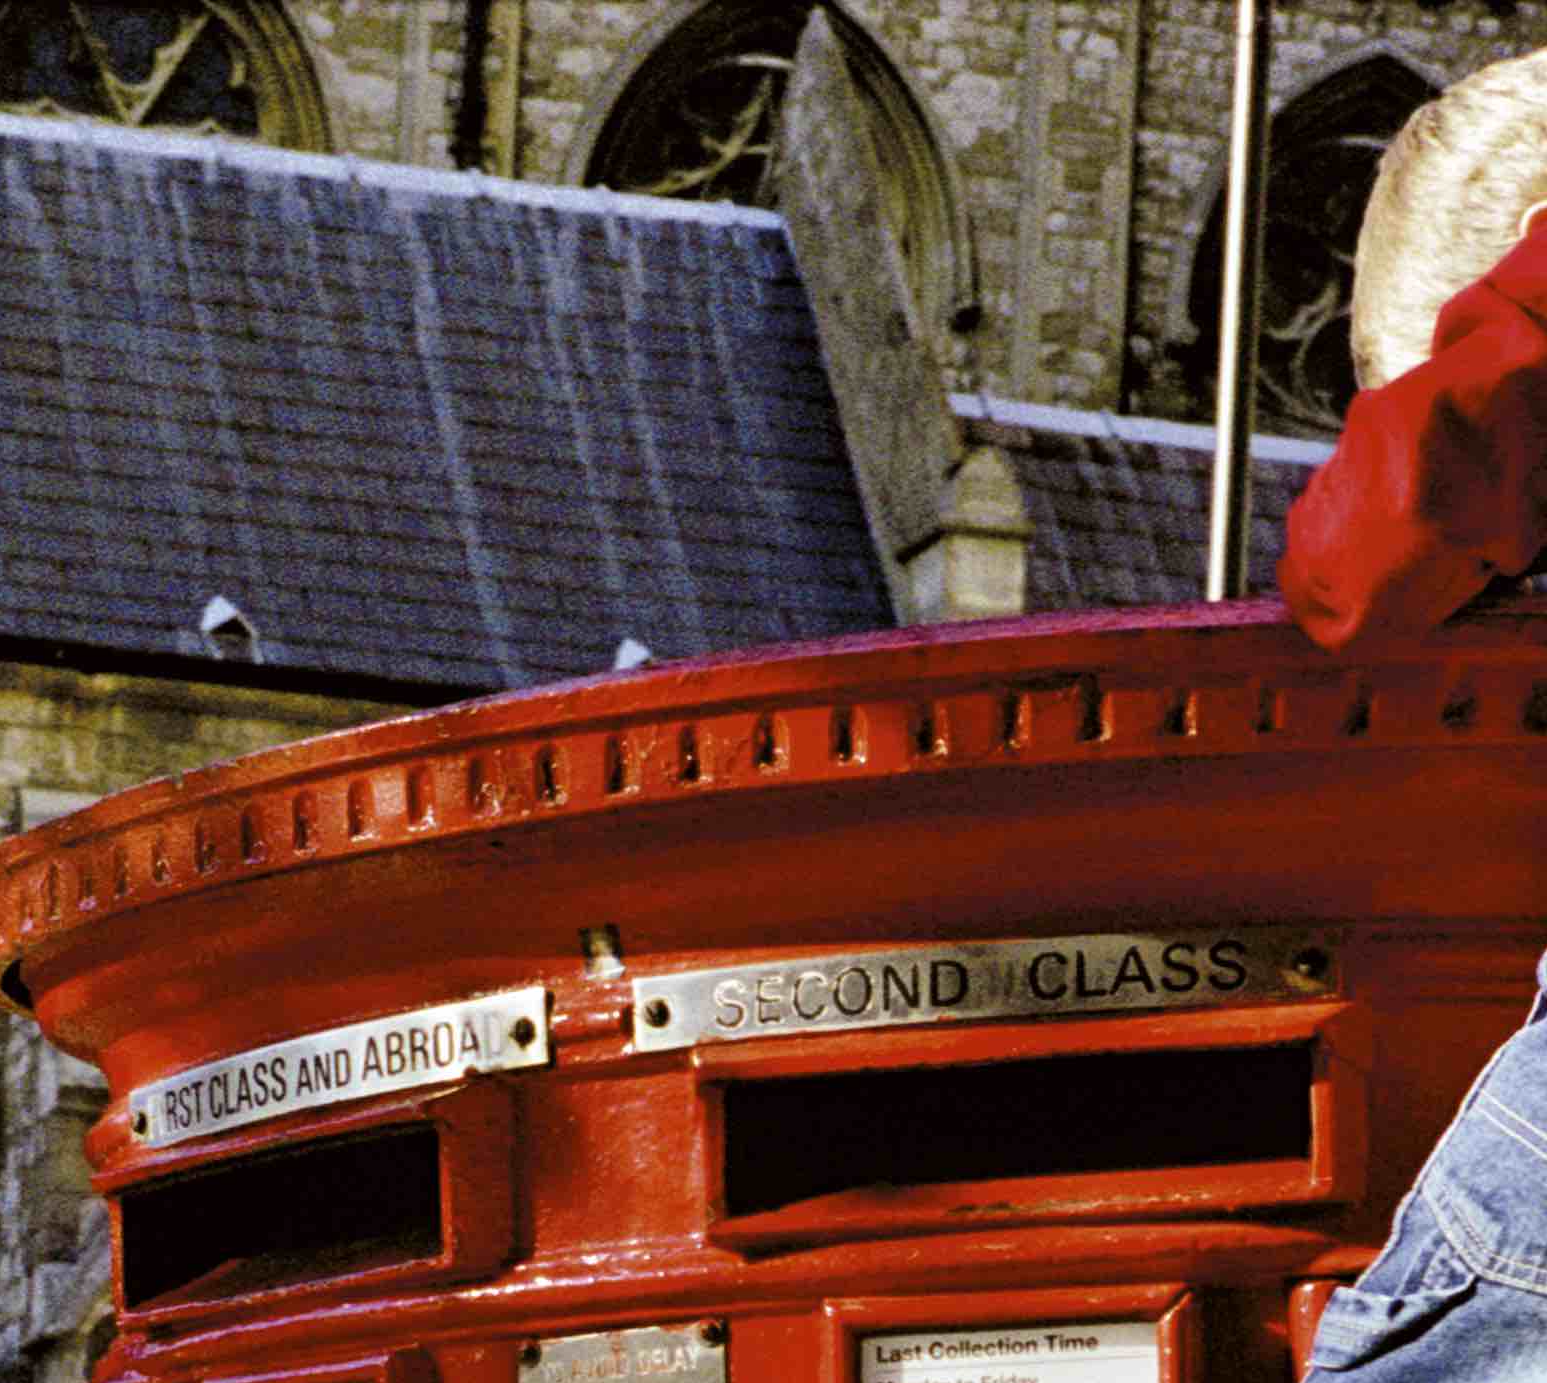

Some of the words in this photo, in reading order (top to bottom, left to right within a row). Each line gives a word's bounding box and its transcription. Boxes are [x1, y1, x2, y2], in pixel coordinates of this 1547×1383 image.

[715, 960, 969, 1029] SECOND
[1028, 940, 1247, 999] CLASS
[209, 1059, 287, 1119] CLASS
[296, 1050, 350, 1096] AND
[362, 1010, 506, 1080] ABROAD
[876, 1346, 922, 1363] Last
[928, 1338, 1038, 1360] Collection
[1044, 1334, 1099, 1351] Time
